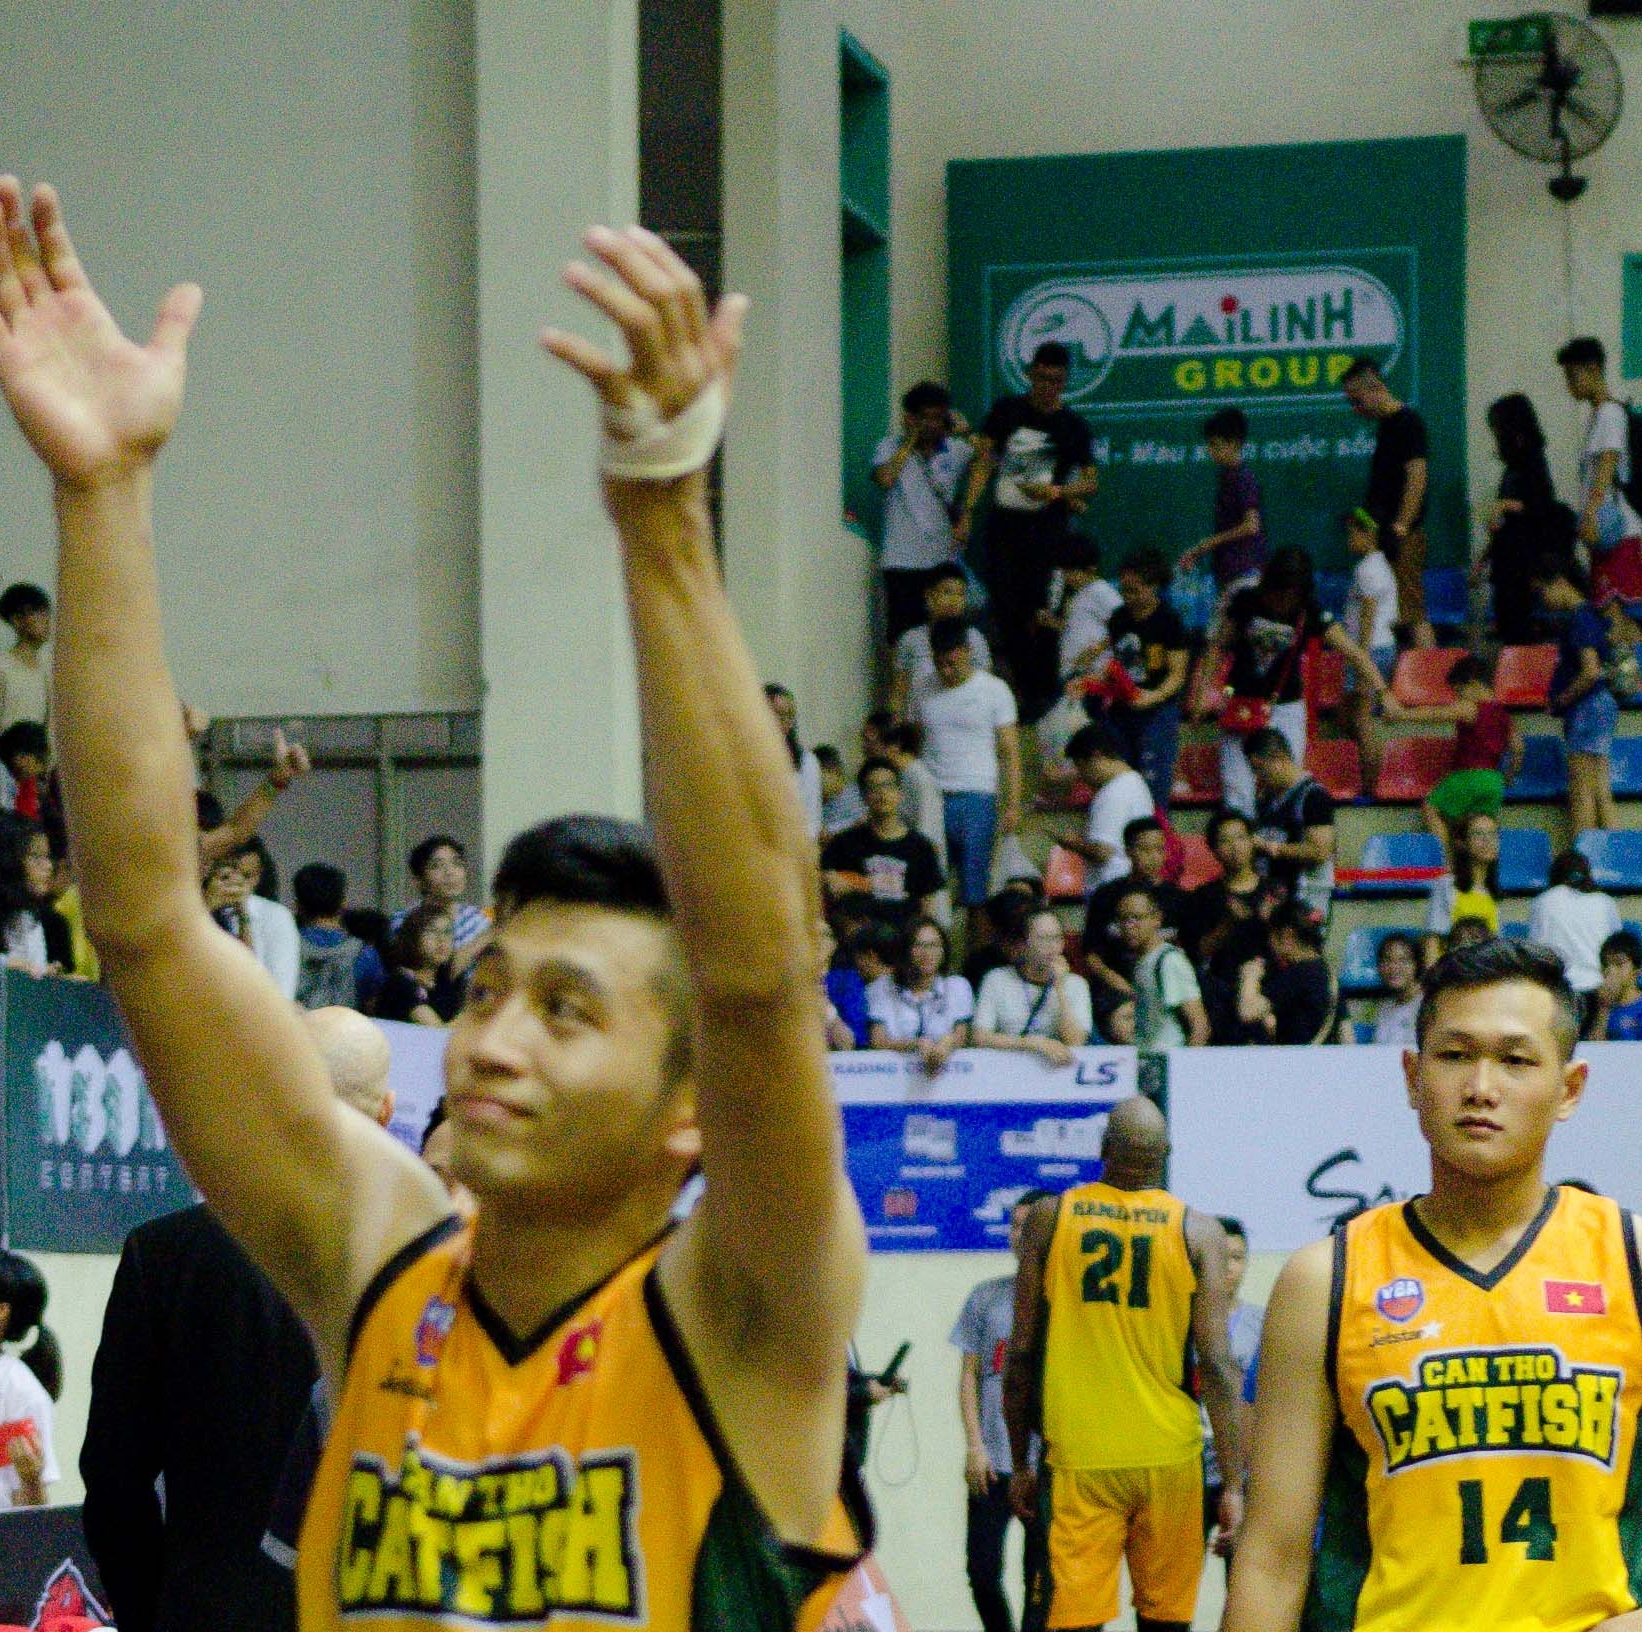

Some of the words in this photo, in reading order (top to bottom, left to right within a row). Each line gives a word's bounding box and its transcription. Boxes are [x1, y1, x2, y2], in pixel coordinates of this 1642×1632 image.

[1175, 354, 1354, 391] GROUP
[1076, 1062, 1119, 1086] LS
[1081, 1228, 1151, 1308] 21
[1422, 1356, 1488, 1386] CAN
[1494, 1355, 1556, 1382] THO
[1371, 1373, 1619, 1468] CATFISH
[339, 1464, 631, 1619] CATFISH
[1458, 1476, 1558, 1565] 14
